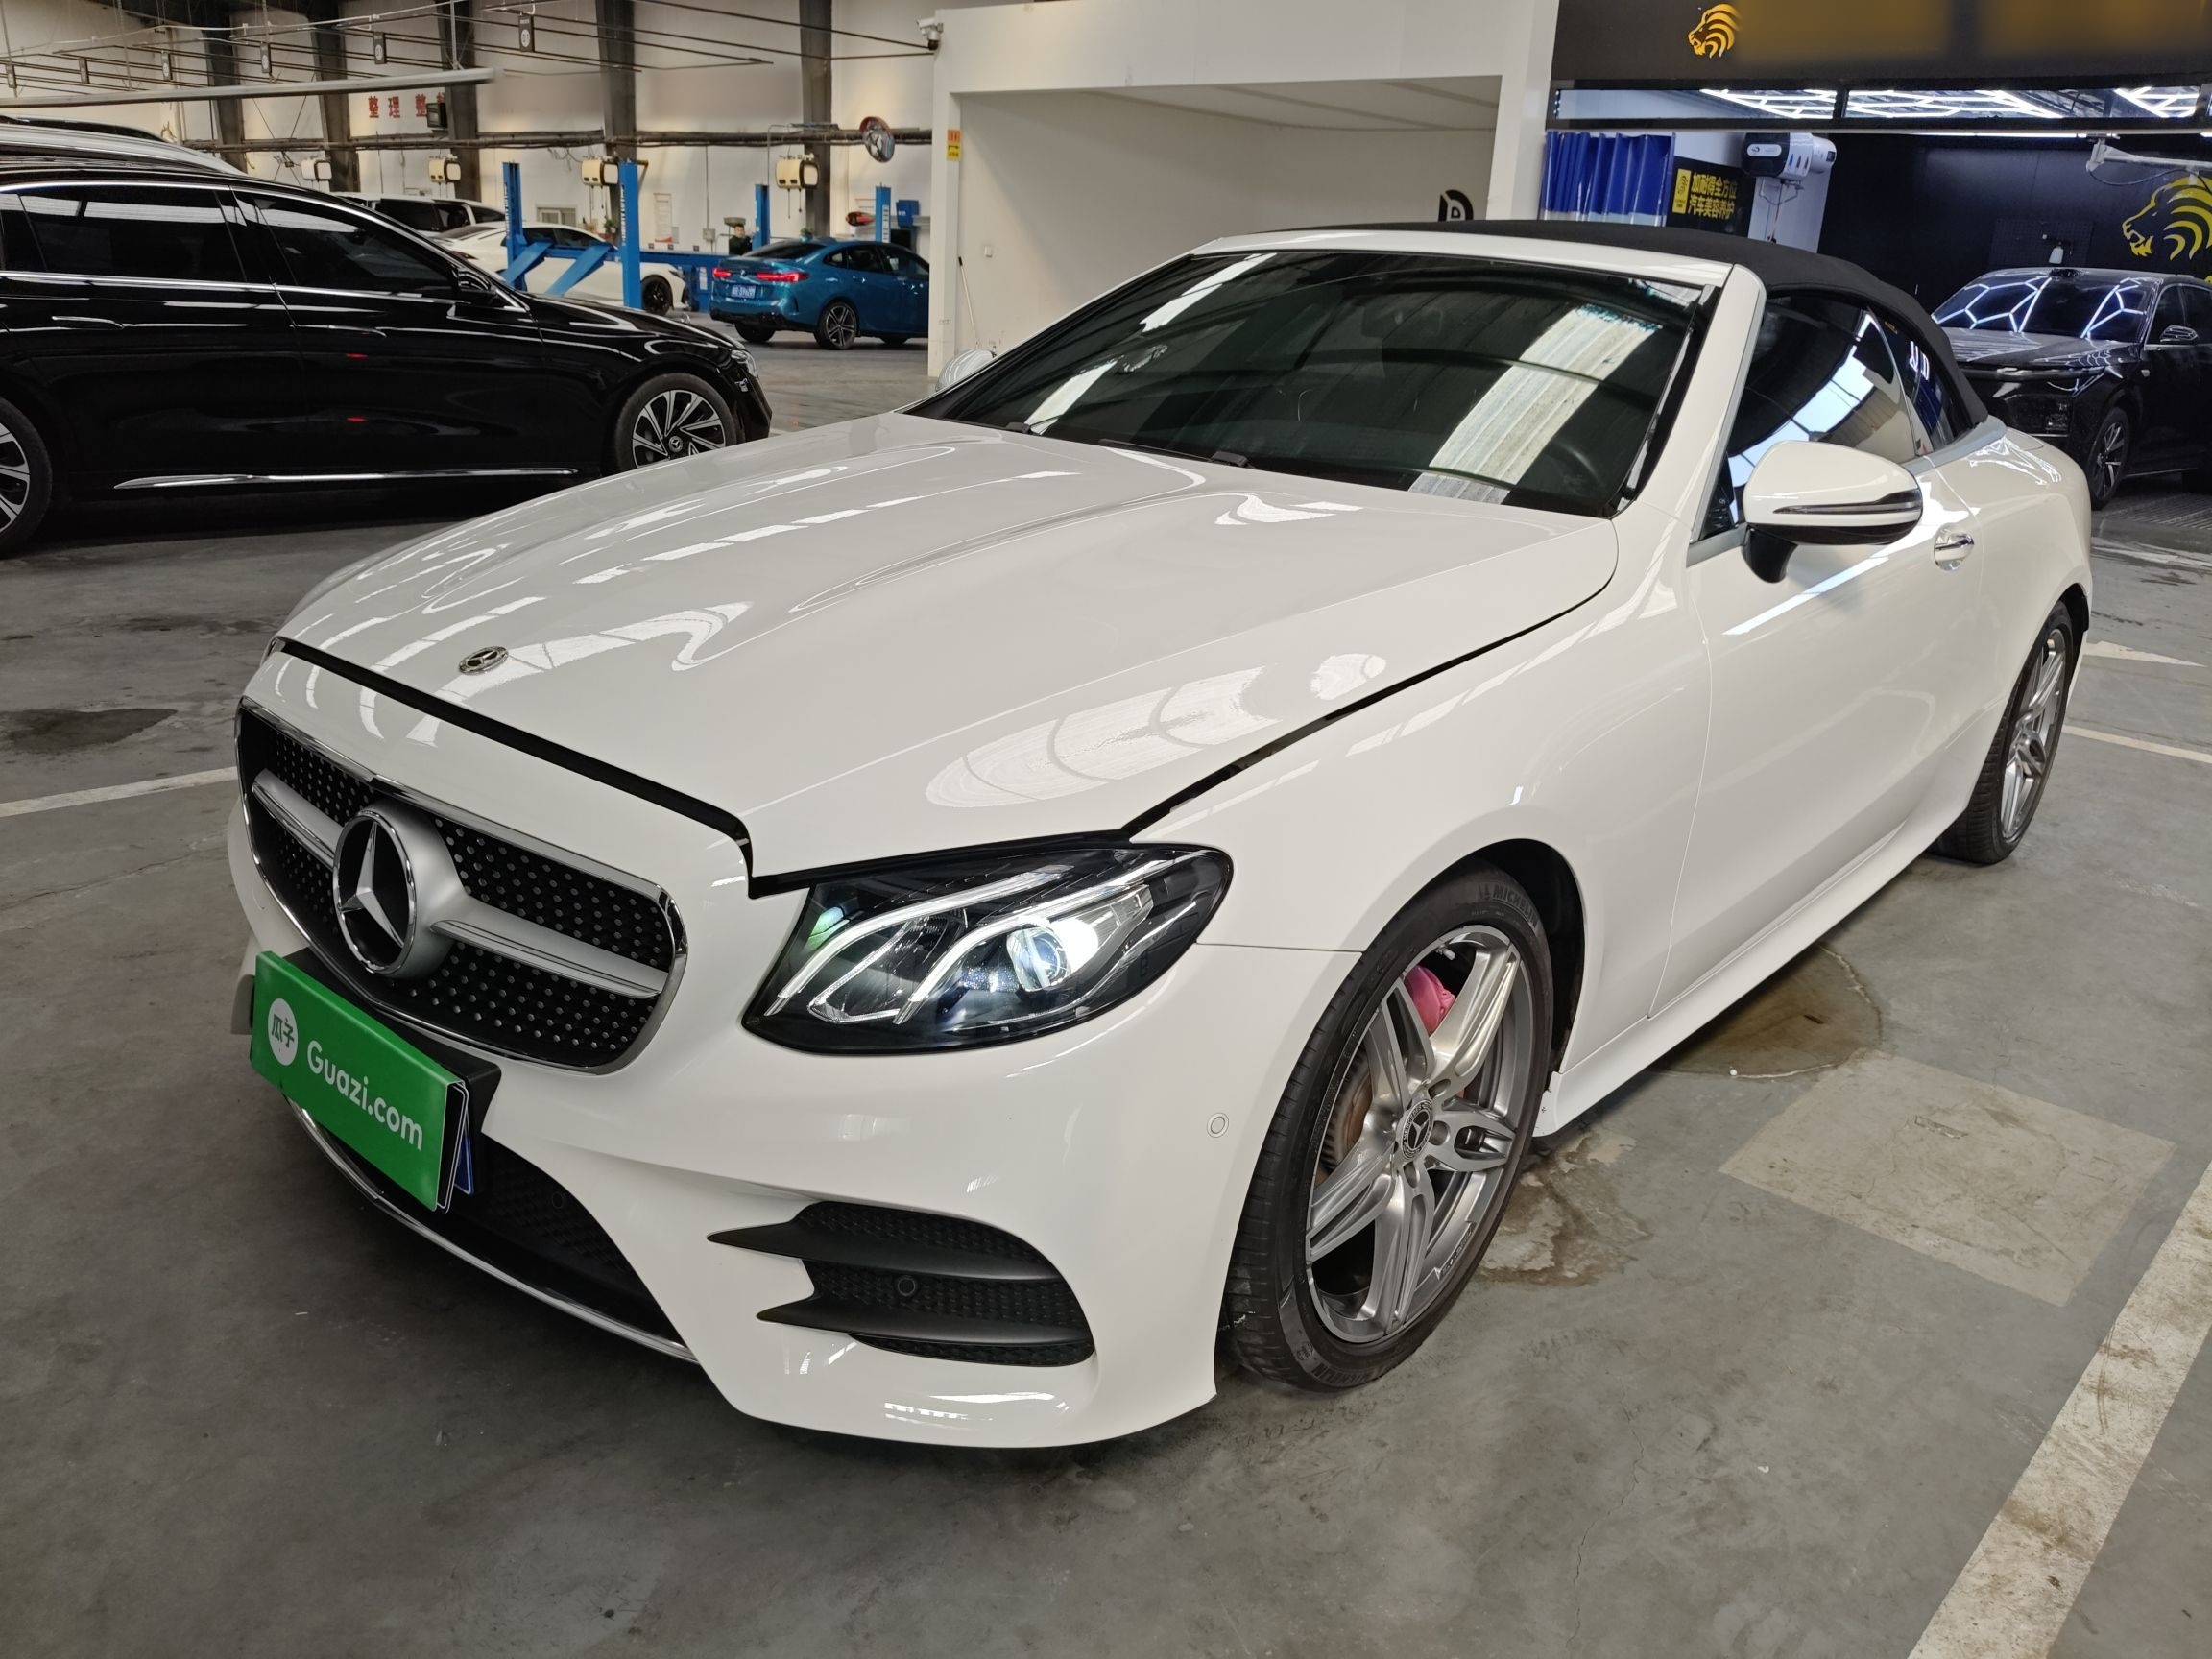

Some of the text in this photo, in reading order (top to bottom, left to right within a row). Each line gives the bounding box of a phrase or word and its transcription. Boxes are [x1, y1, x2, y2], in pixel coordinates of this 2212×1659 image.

[1688, 194, 1735, 220] 汽车美容养护
[271, 1014, 295, 1048] 瓜子
[307, 1040, 422, 1151] Guazi.com
